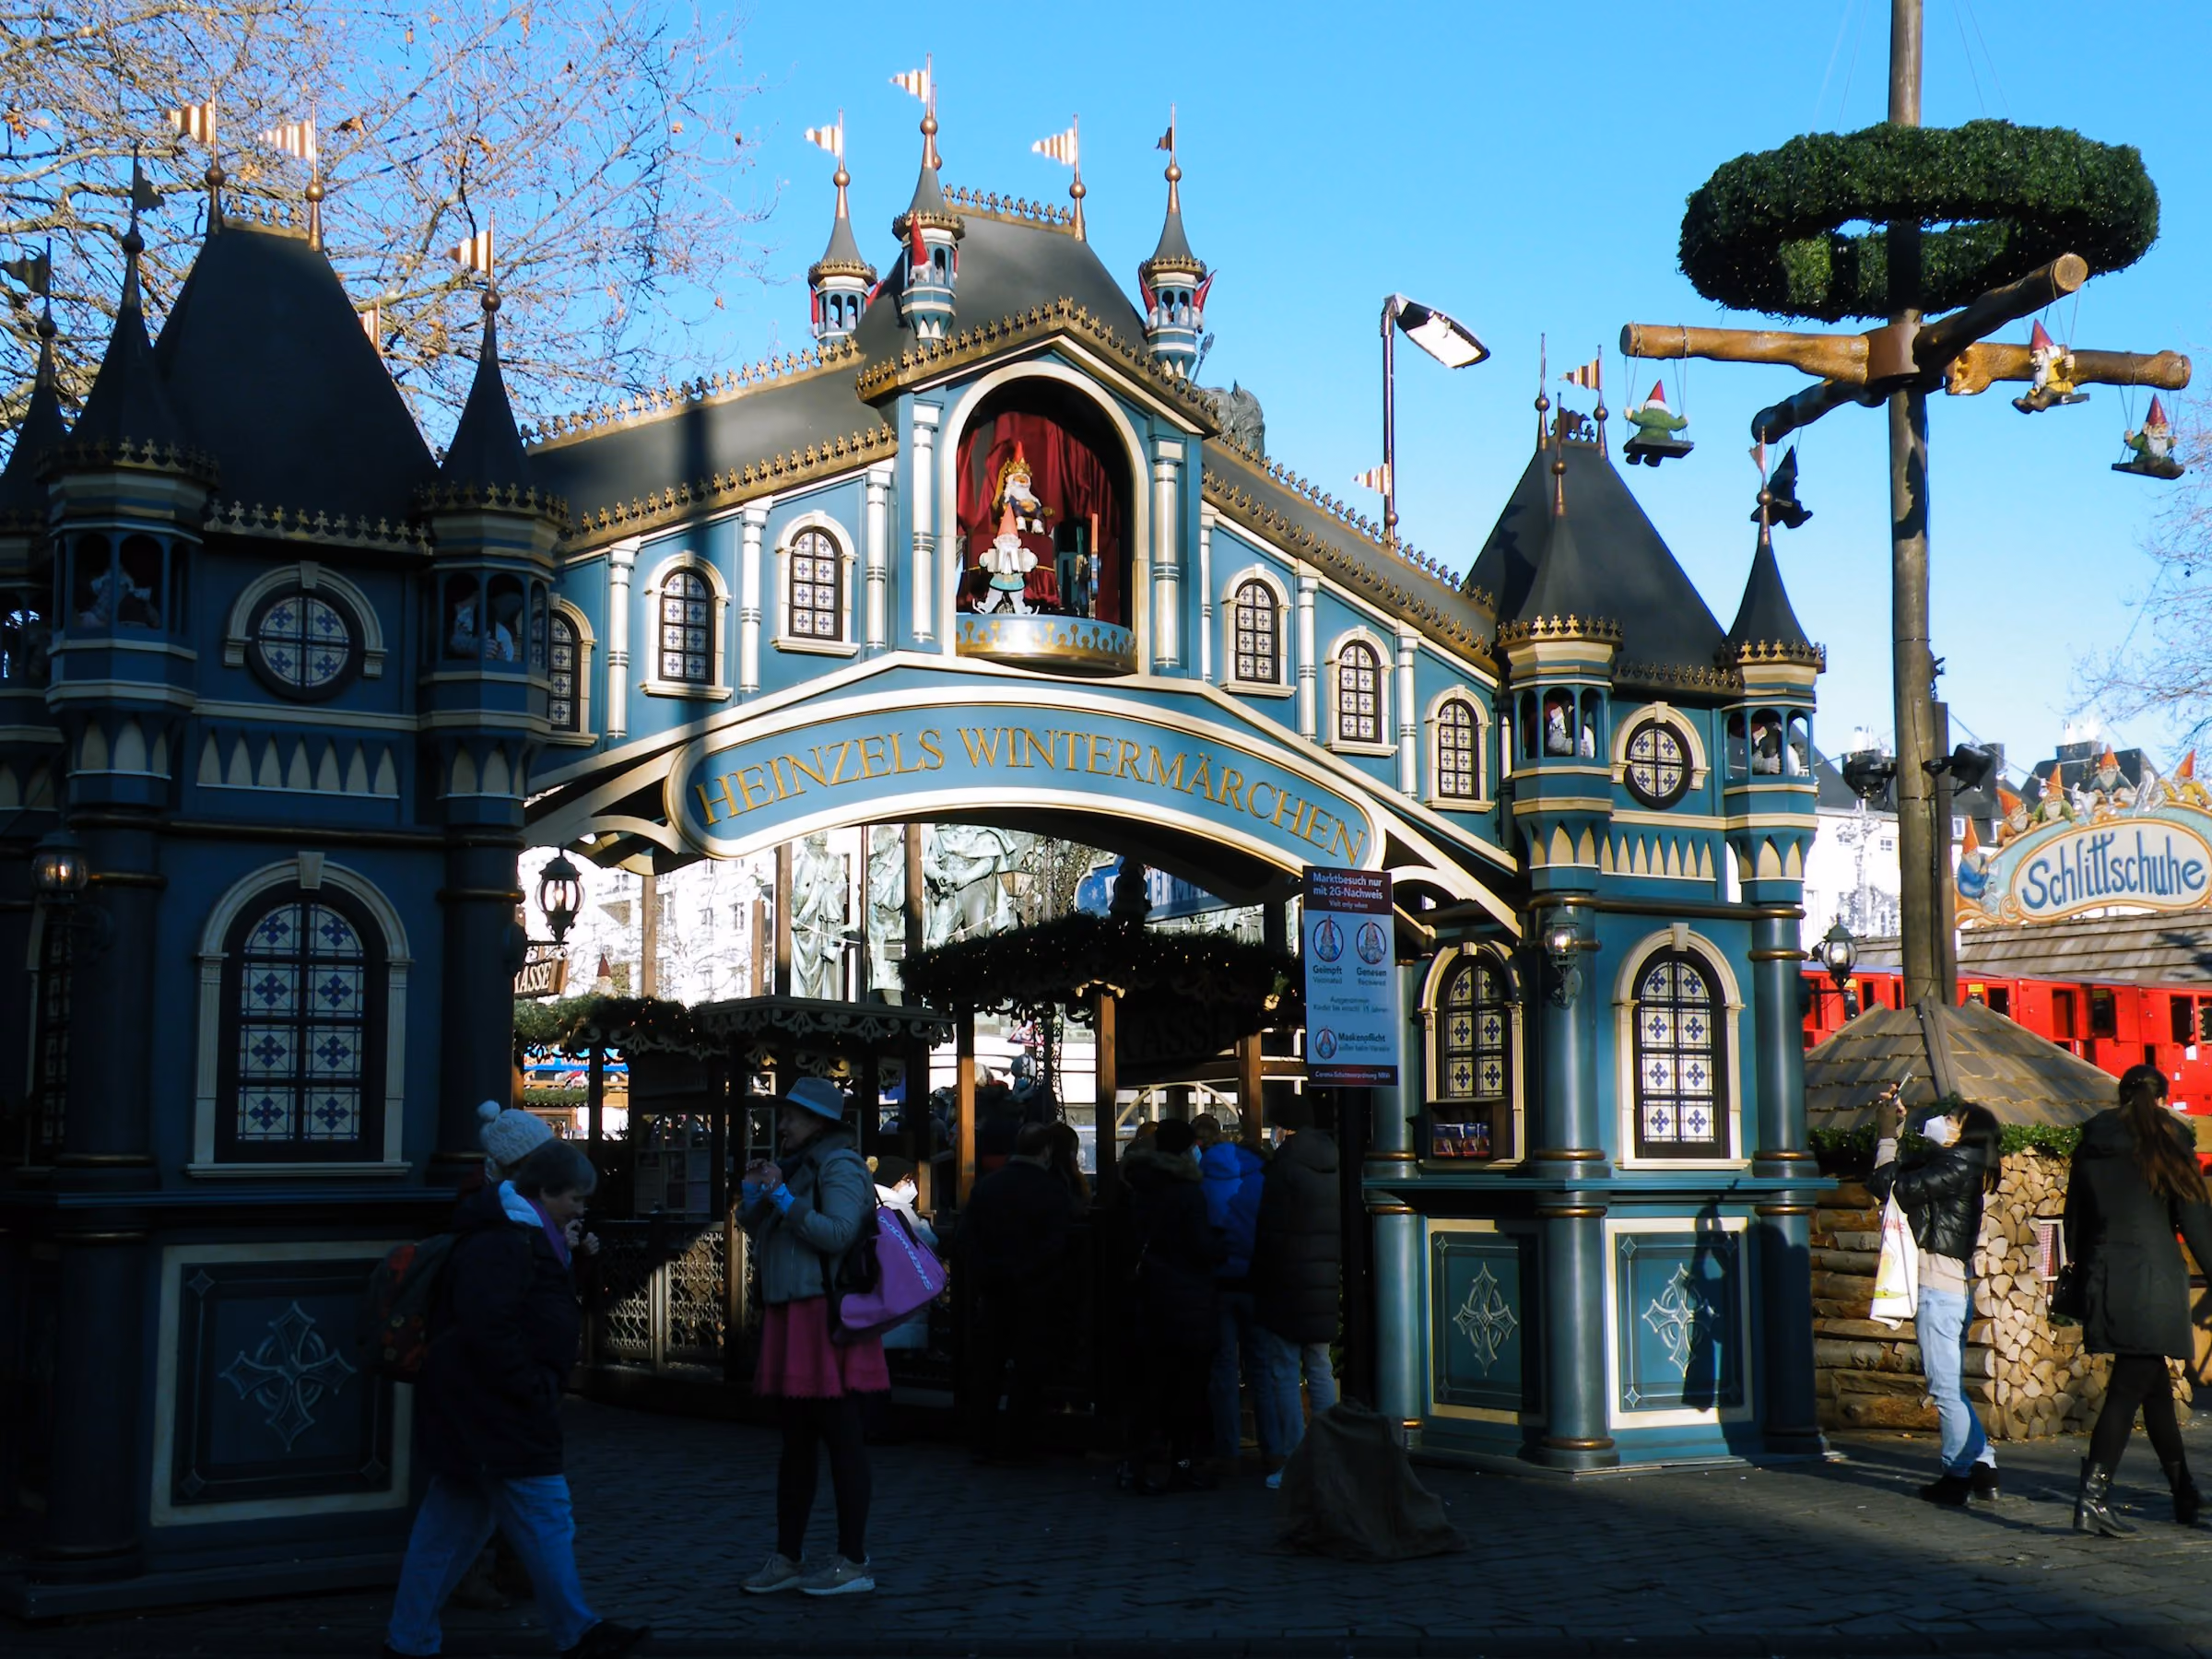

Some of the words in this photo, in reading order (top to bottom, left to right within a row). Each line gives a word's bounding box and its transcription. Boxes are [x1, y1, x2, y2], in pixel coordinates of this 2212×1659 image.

[694, 729, 945, 827] HEINZELS
[958, 727, 1366, 866] WINTERMÄRCHEN
[2021, 830, 2206, 910] Schlittschuhe
[1312, 871, 1366, 886] Marktbesuch
[1368, 877, 1382, 887] nur
[1312, 885, 1327, 896] mit
[1329, 886, 1383, 900] 2G-Nachweis
[1312, 964, 1343, 976] Geimpft
[1357, 967, 1387, 977] Genesen
[1338, 1032, 1386, 1043] Maskenpflicht
